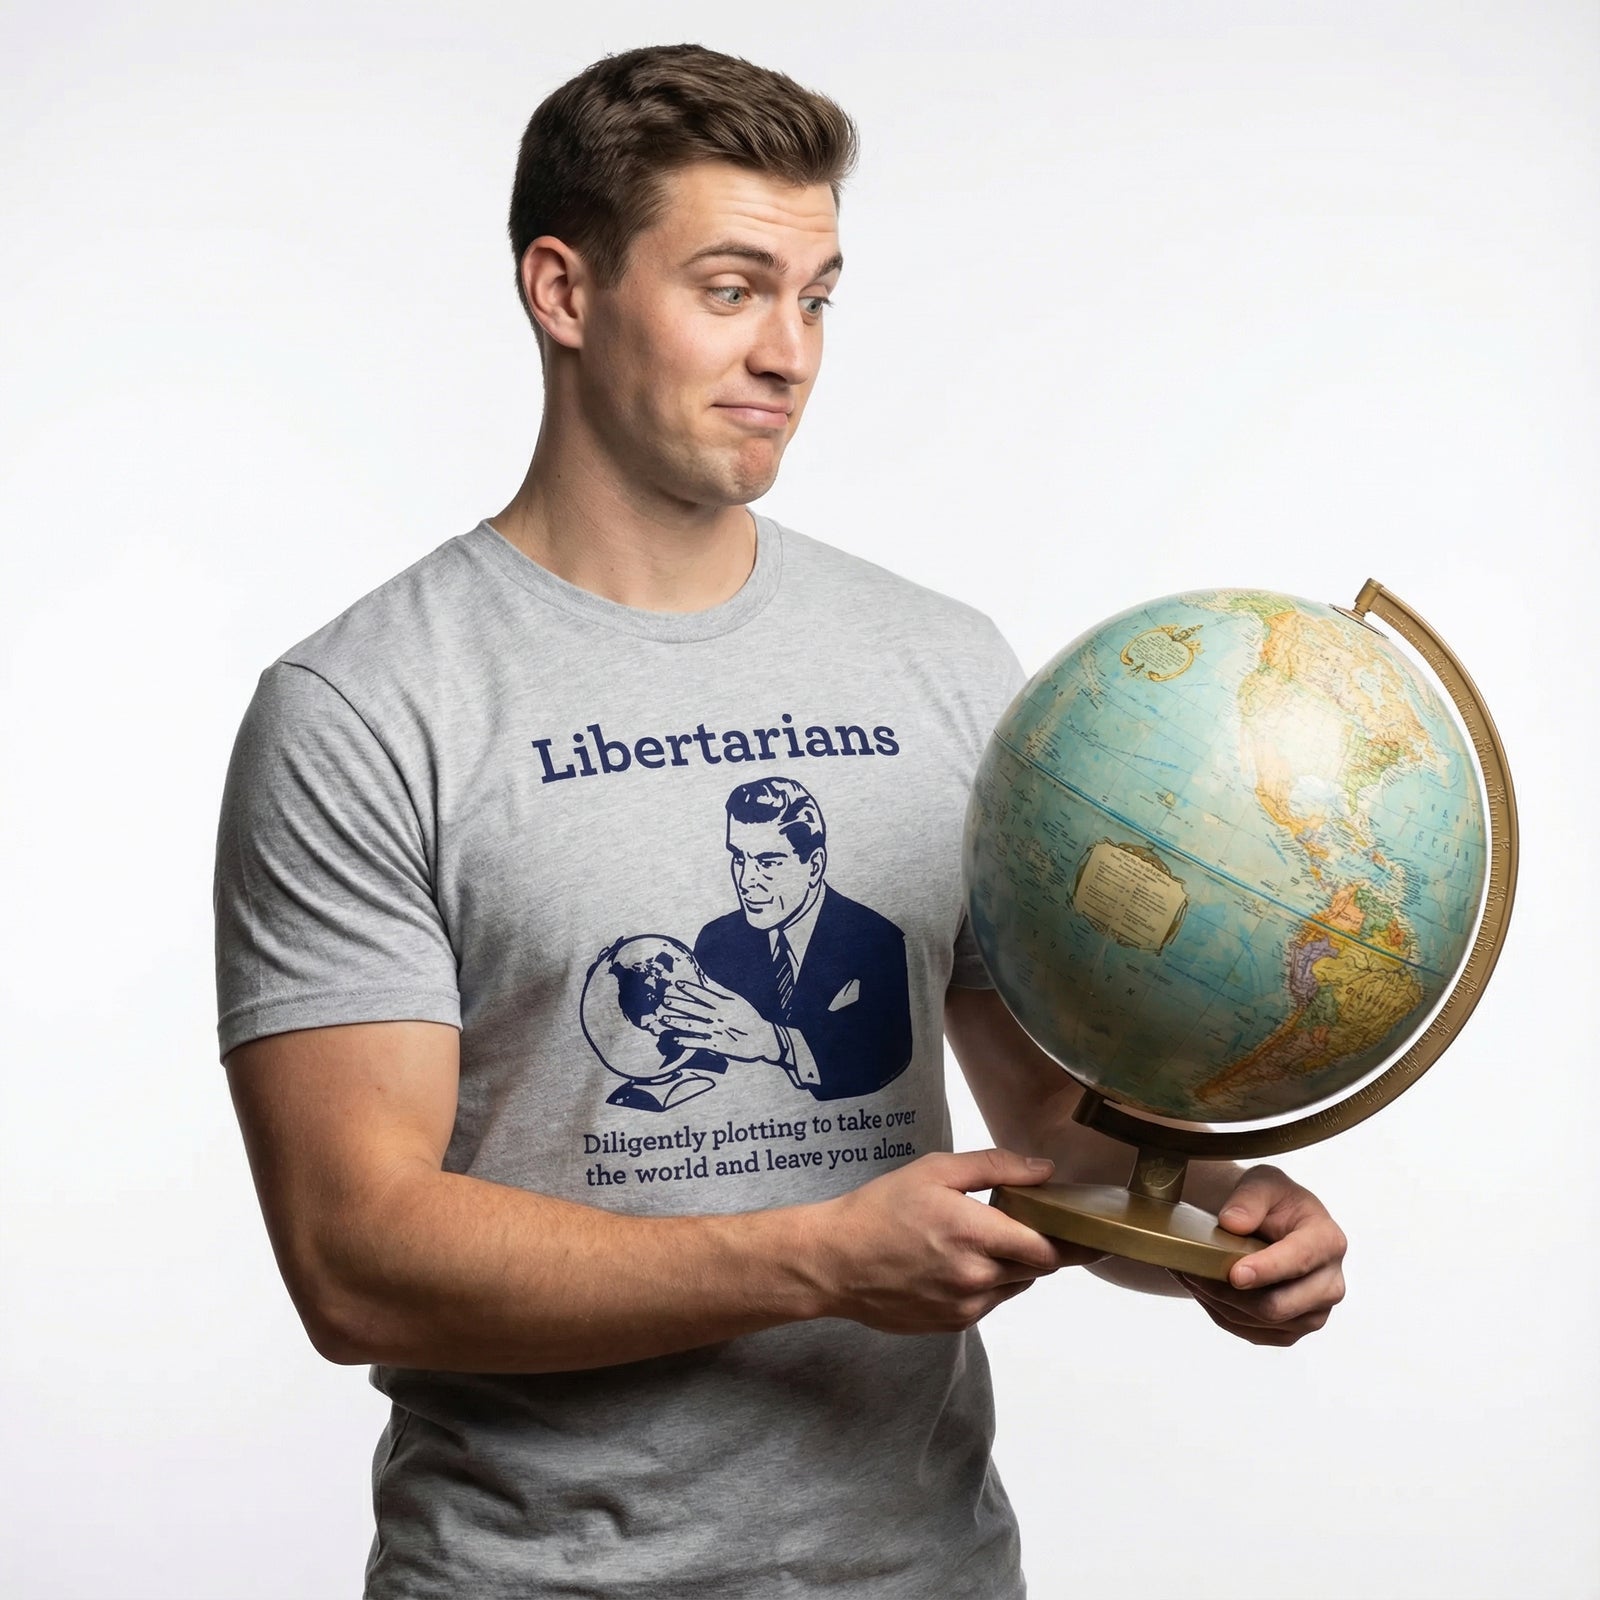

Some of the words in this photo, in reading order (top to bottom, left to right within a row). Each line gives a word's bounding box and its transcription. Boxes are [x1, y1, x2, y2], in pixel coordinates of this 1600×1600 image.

[532, 713, 900, 783] Libertarians
[584, 1126, 707, 1157] Diligently
[712, 1118, 806, 1146] plotting
[812, 1116, 832, 1134] to
[837, 1109, 882, 1131] take
[886, 1109, 916, 1127] over
[586, 1164, 627, 1186] the
[635, 1156, 709, 1183] world
[715, 1152, 759, 1176] and
[766, 1149, 823, 1170] leave
[828, 1147, 869, 1169] you
[873, 1138, 916, 1160] alone.
